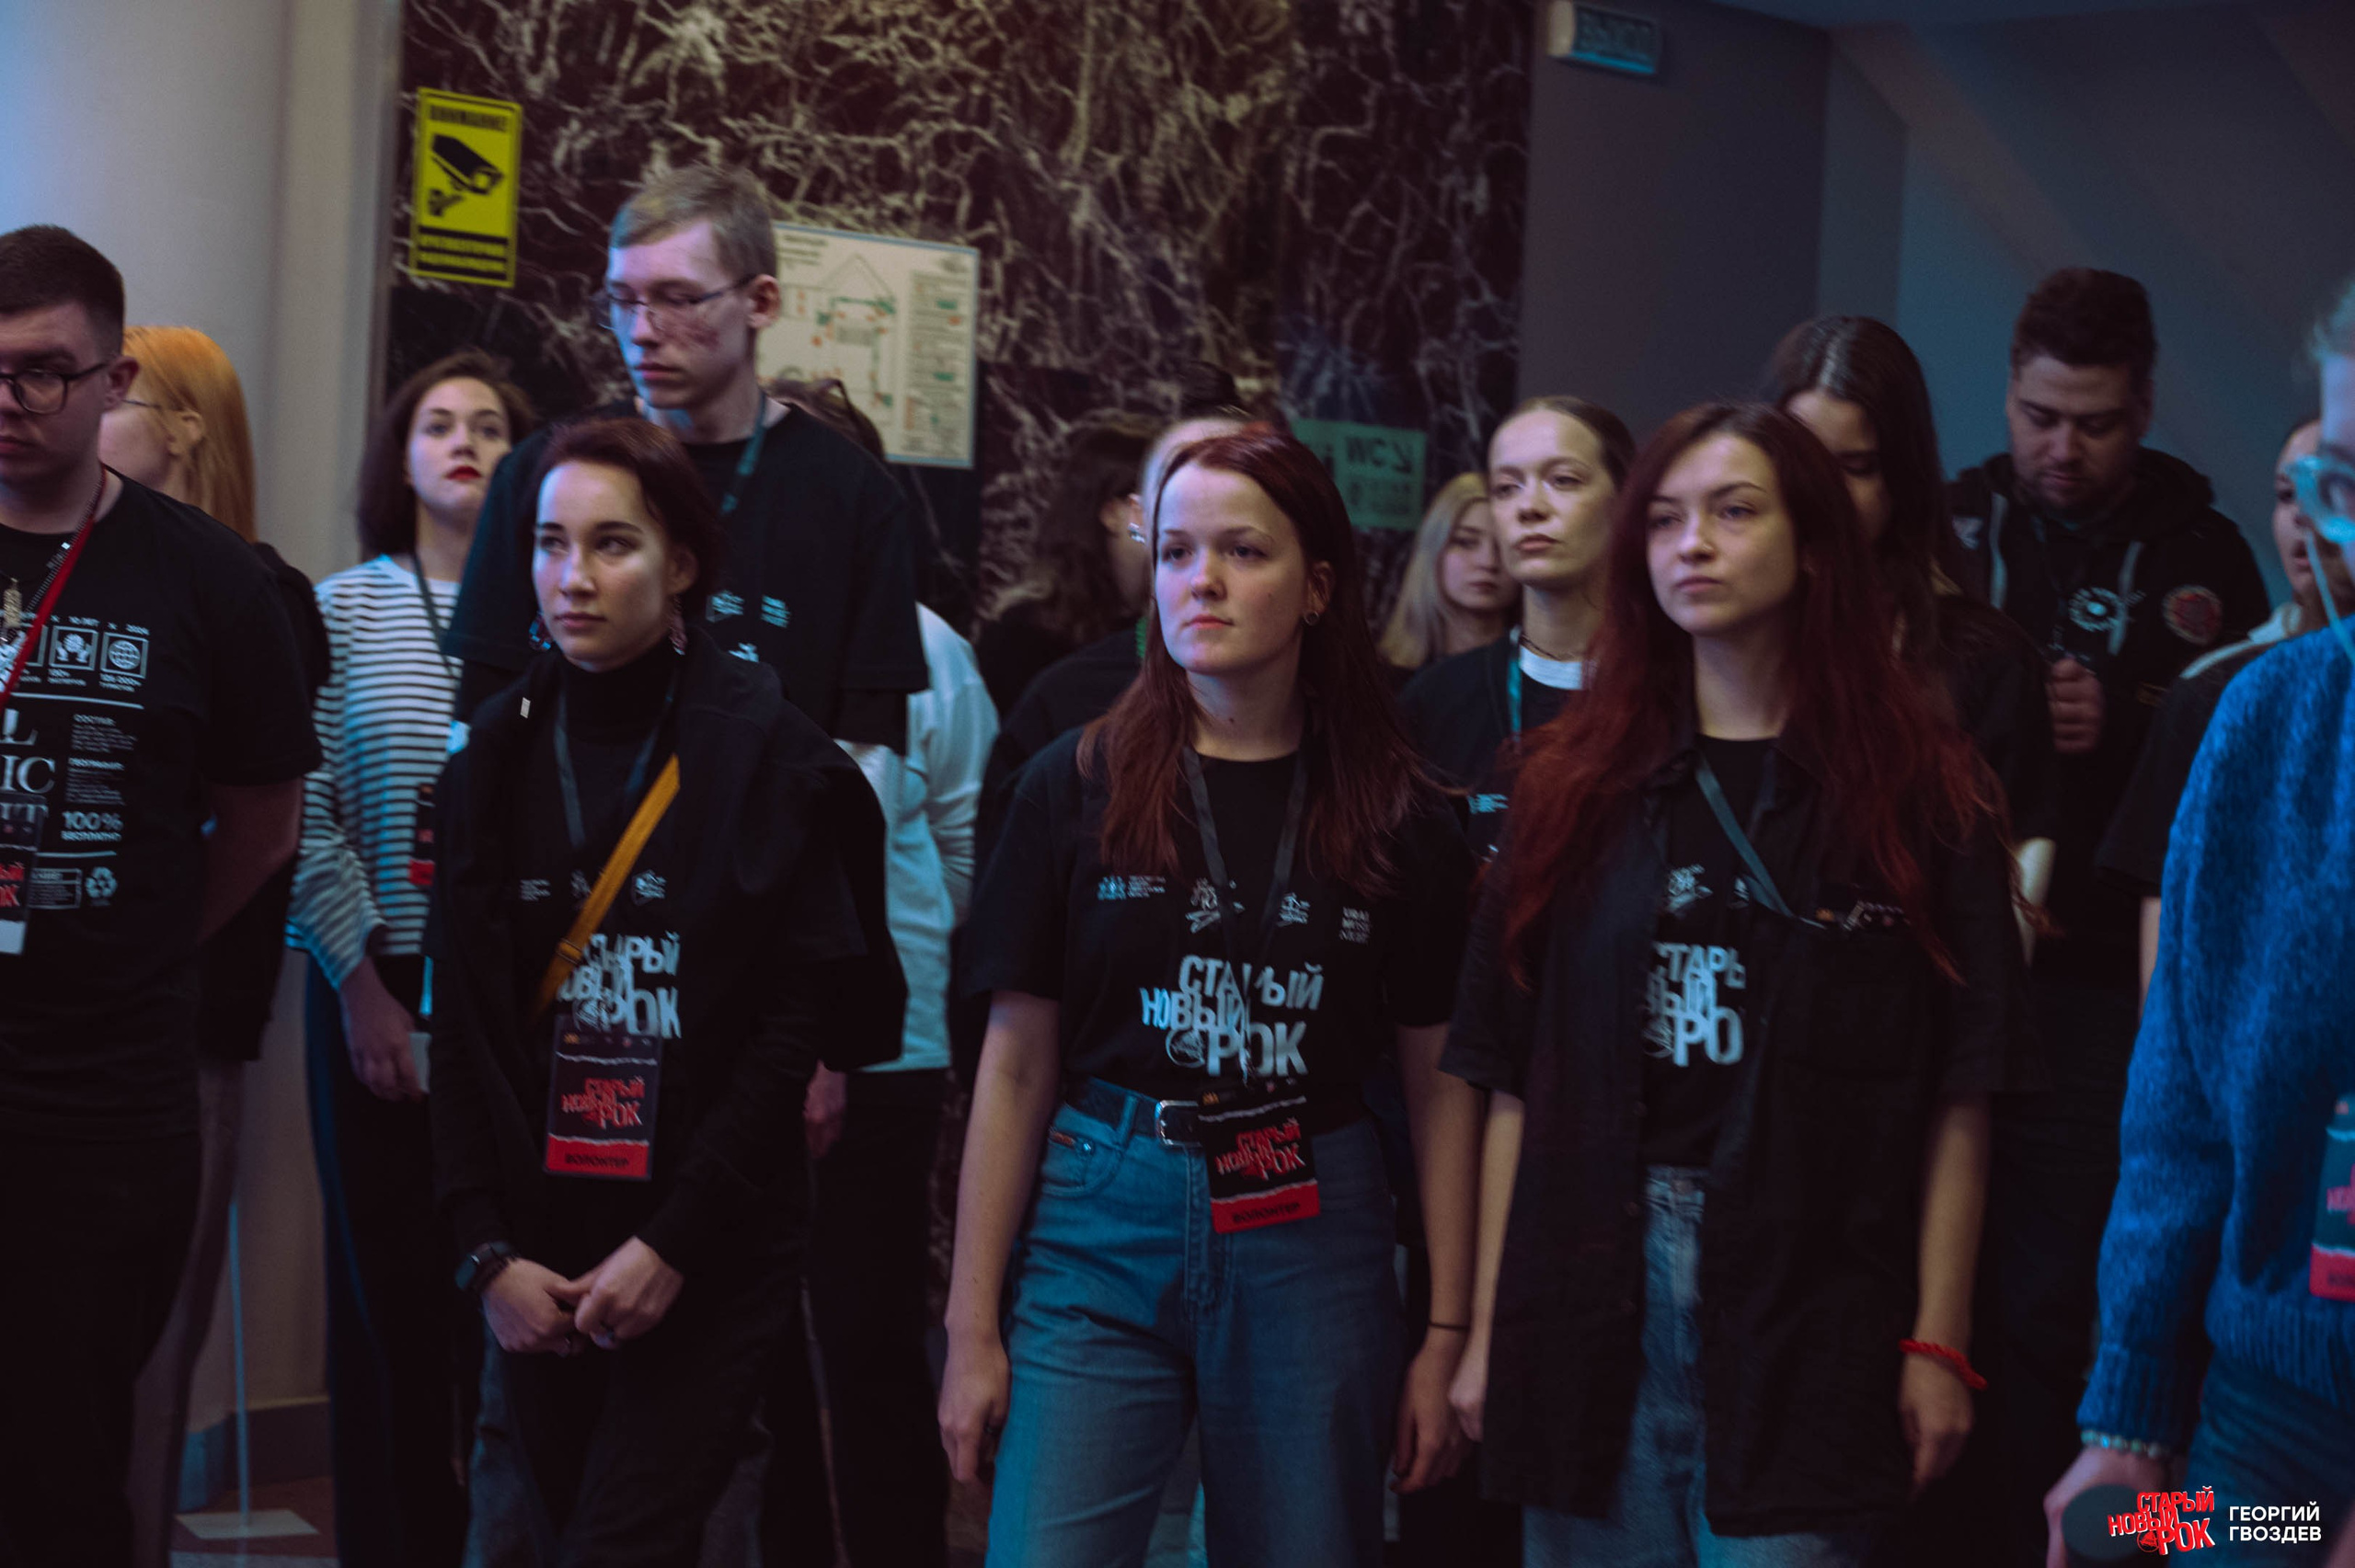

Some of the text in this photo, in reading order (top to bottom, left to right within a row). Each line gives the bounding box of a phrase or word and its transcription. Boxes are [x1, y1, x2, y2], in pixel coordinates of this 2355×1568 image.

[1346, 436, 1385, 467] WC
[62, 811, 124, 830] 100%
[1207, 1020, 1310, 1078] РОК
[1673, 1005, 1744, 1068] РО
